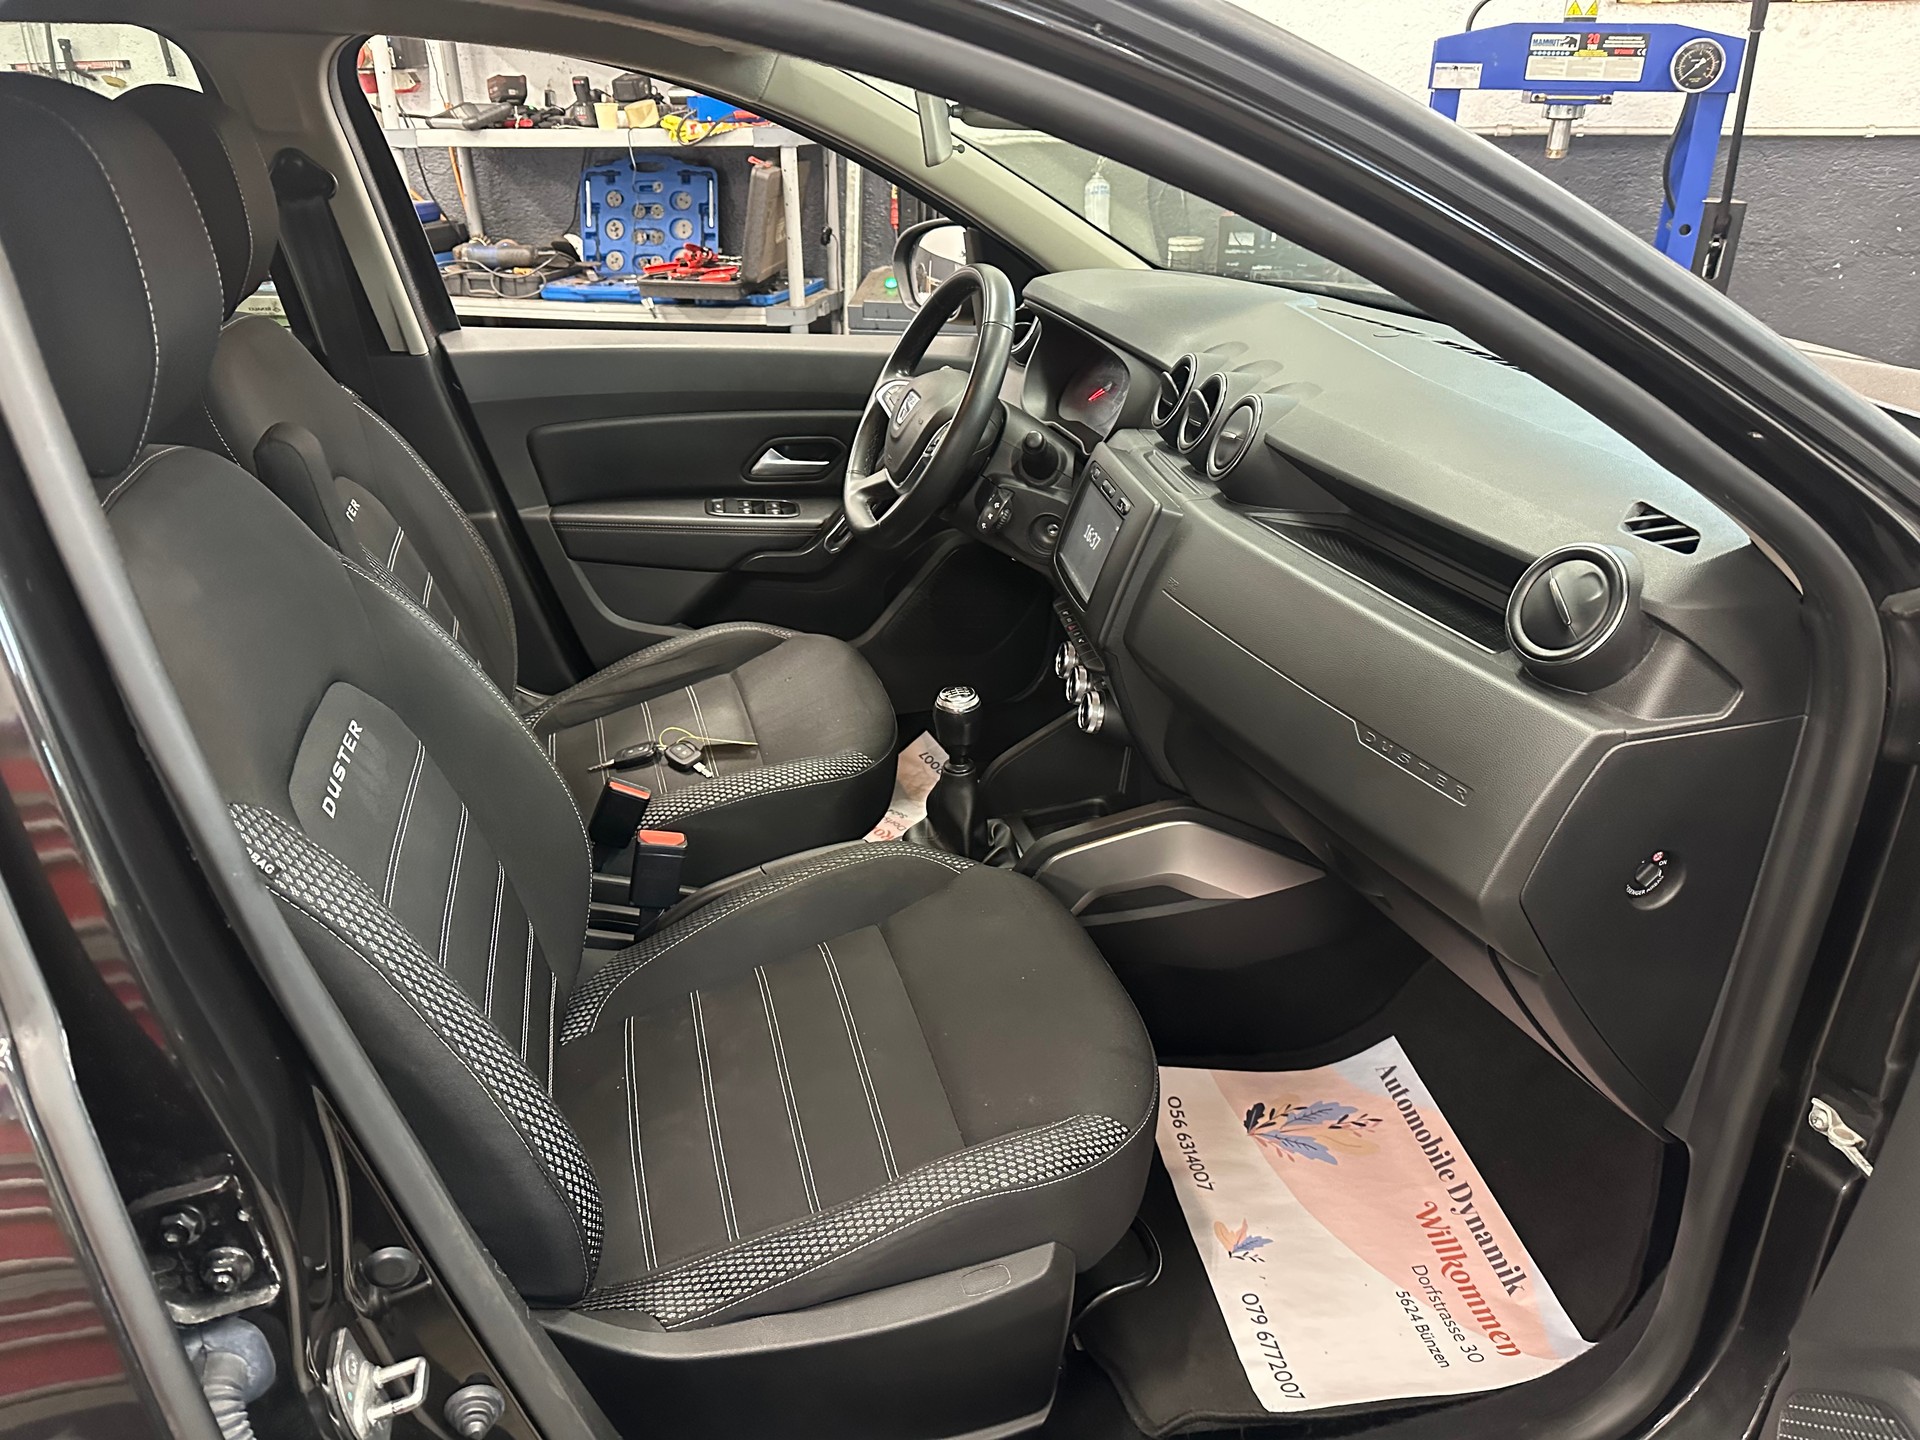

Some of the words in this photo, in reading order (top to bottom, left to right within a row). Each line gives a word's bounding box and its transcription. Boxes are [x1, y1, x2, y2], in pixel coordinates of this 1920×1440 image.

[1586, 33, 1600, 44] 20
[1083, 524, 1101, 550] 16:37
[321, 719, 364, 819] DUSTER
[1364, 730, 1468, 801] DUSTER
[1167, 1095, 1188, 1129] 056
[1176, 1131, 1214, 1192] 6314007
[1374, 1063, 1456, 1183] Automobile
[1446, 1180, 1528, 1297] Dynamik
[1411, 1264, 1466, 1343] Dorfstrasse
[1459, 1344, 1485, 1363] 30
[1415, 1200, 1522, 1357] Willkommen
[1241, 1292, 1268, 1325] 079
[1255, 1330, 1307, 1399] 6772007
[1395, 1290, 1425, 1323] 5624
[1414, 1323, 1451, 1369] Bünzen
